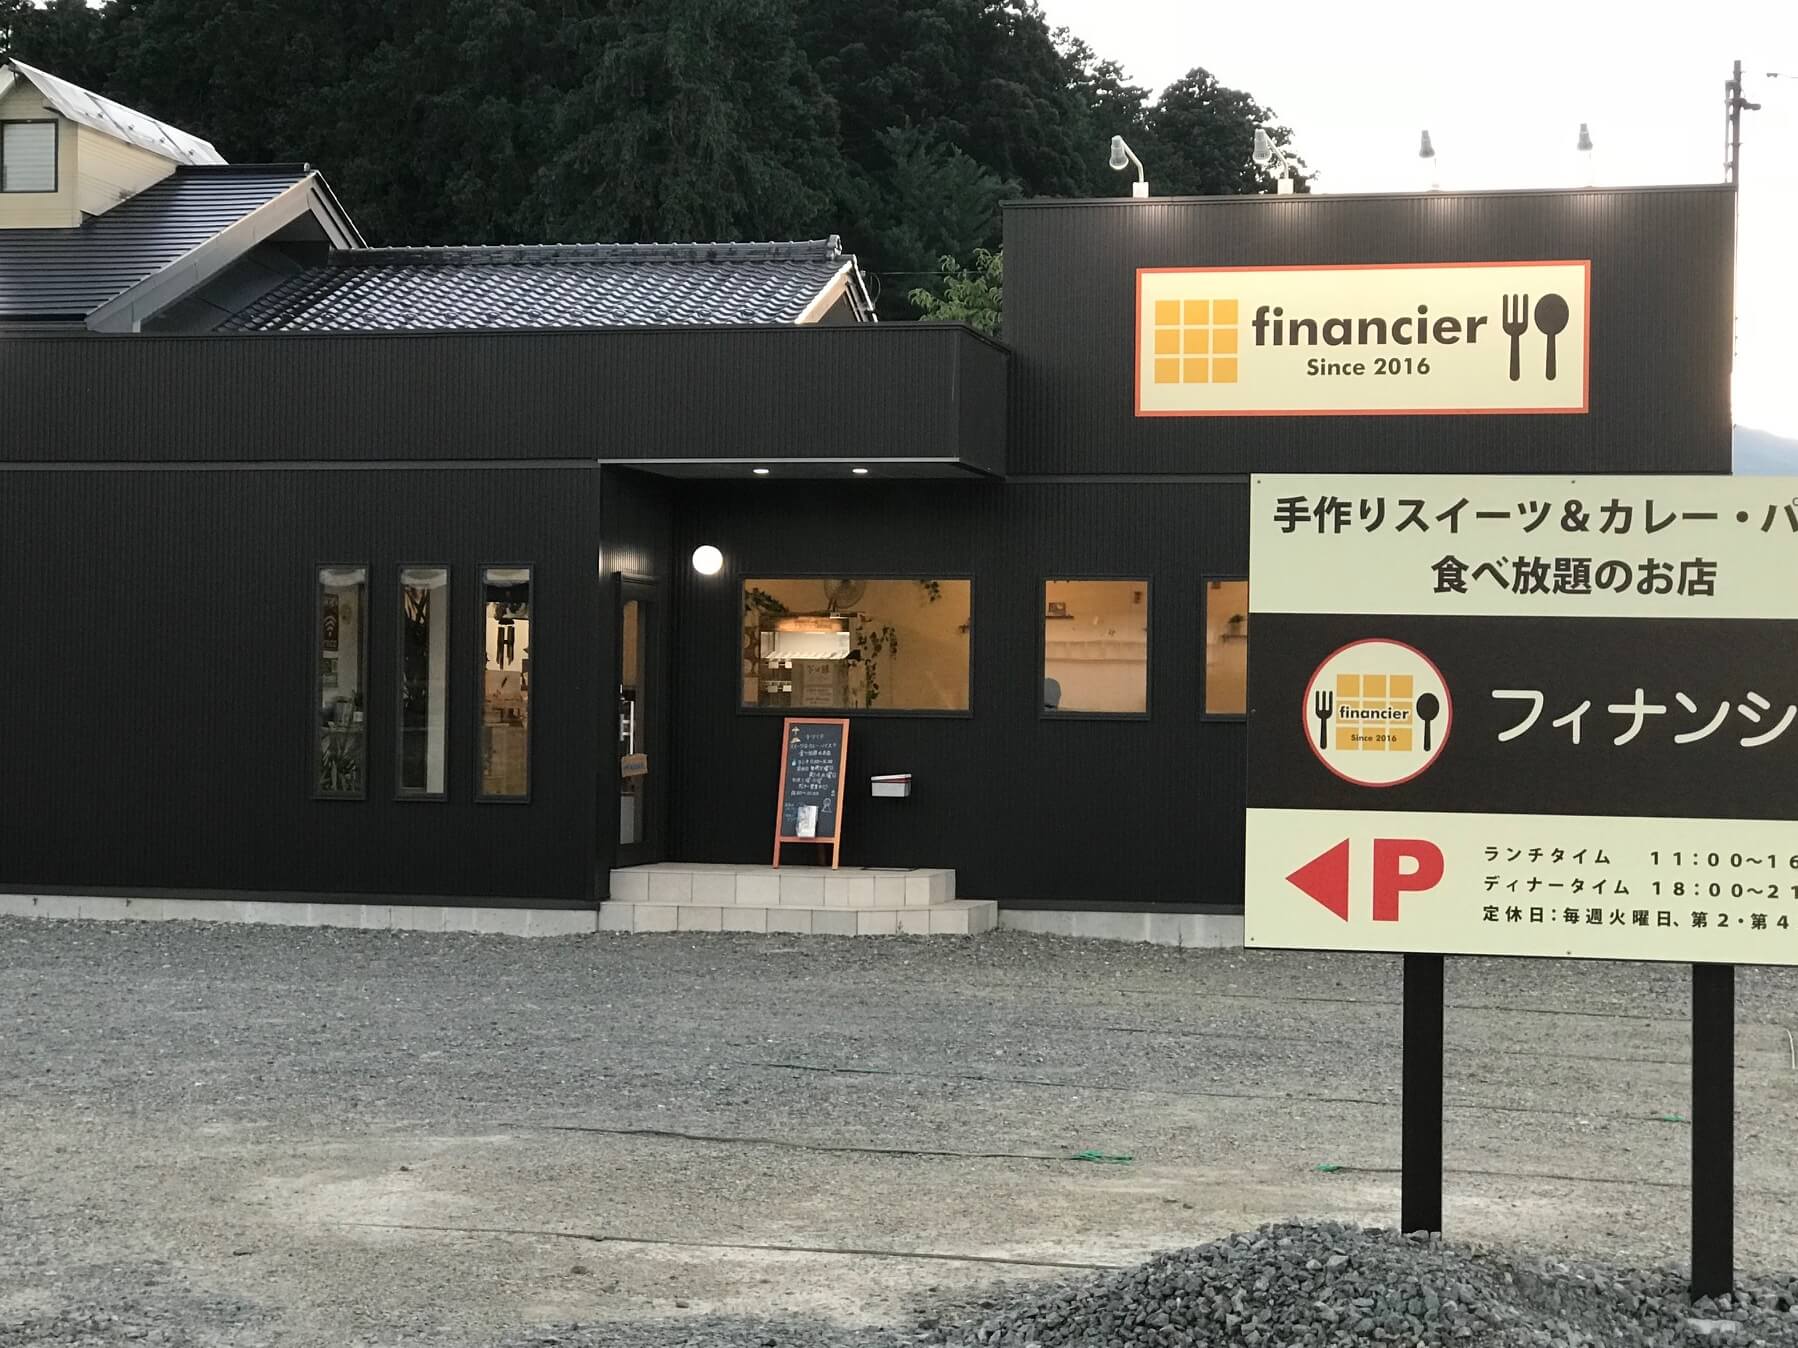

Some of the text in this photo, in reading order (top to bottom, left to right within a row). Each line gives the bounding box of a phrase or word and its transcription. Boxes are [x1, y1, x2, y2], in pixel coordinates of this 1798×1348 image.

[1251, 304, 1488, 346] financier
[1307, 357, 1431, 376] Since 2016
[1430, 554, 1718, 597] 食べ放題のお店
[1339, 705, 1409, 719] financier
[1491, 687, 1798, 747] フィナンシ
[1350, 734, 1397, 743] Since 2016
[1484, 846, 1611, 866] ランチタイム
[1372, 838, 1445, 922] P
[1484, 874, 1630, 896] ディナータイム
